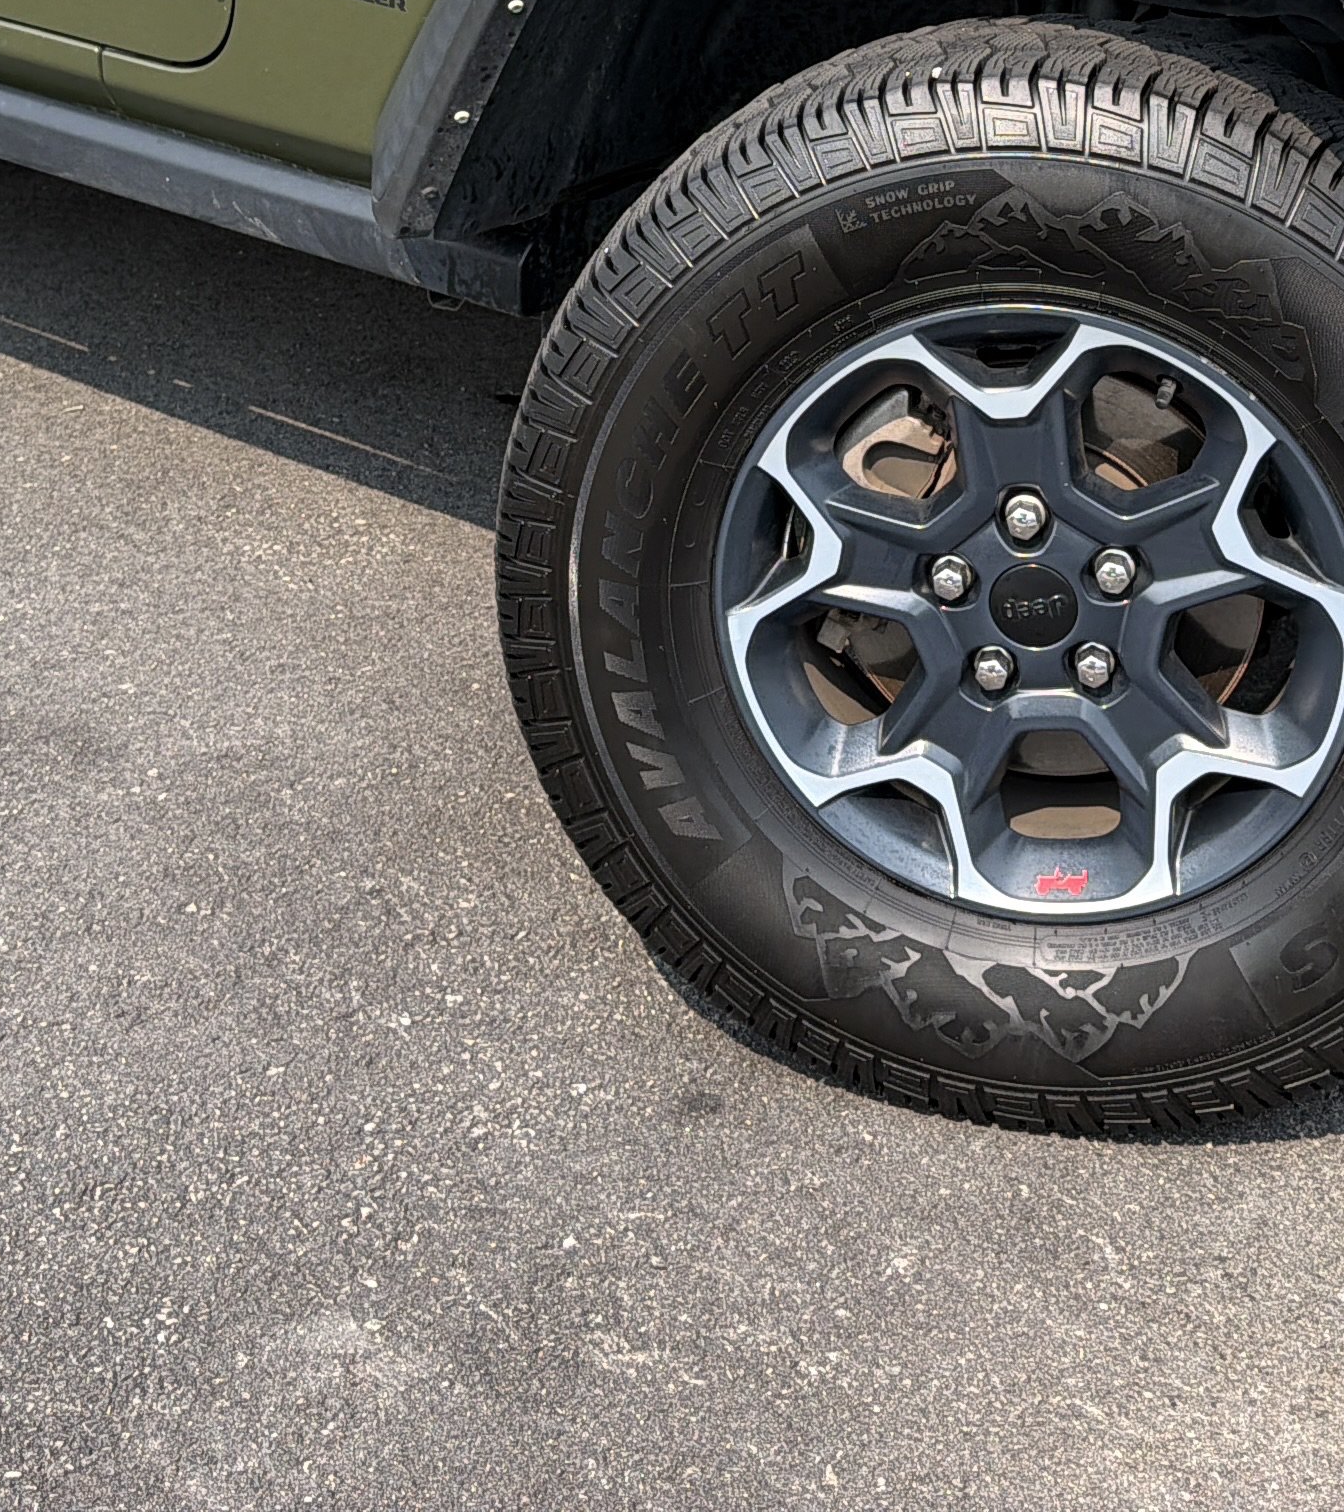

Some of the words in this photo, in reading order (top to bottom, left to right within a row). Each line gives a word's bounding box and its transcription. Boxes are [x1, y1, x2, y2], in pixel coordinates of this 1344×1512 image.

[864, 187, 909, 209] SNOW
[917, 179, 956, 197] GRIP
[869, 193, 977, 224] TECHNOLOGY
[598, 349, 723, 842] AVALANCHE
[706, 250, 807, 361] TT
